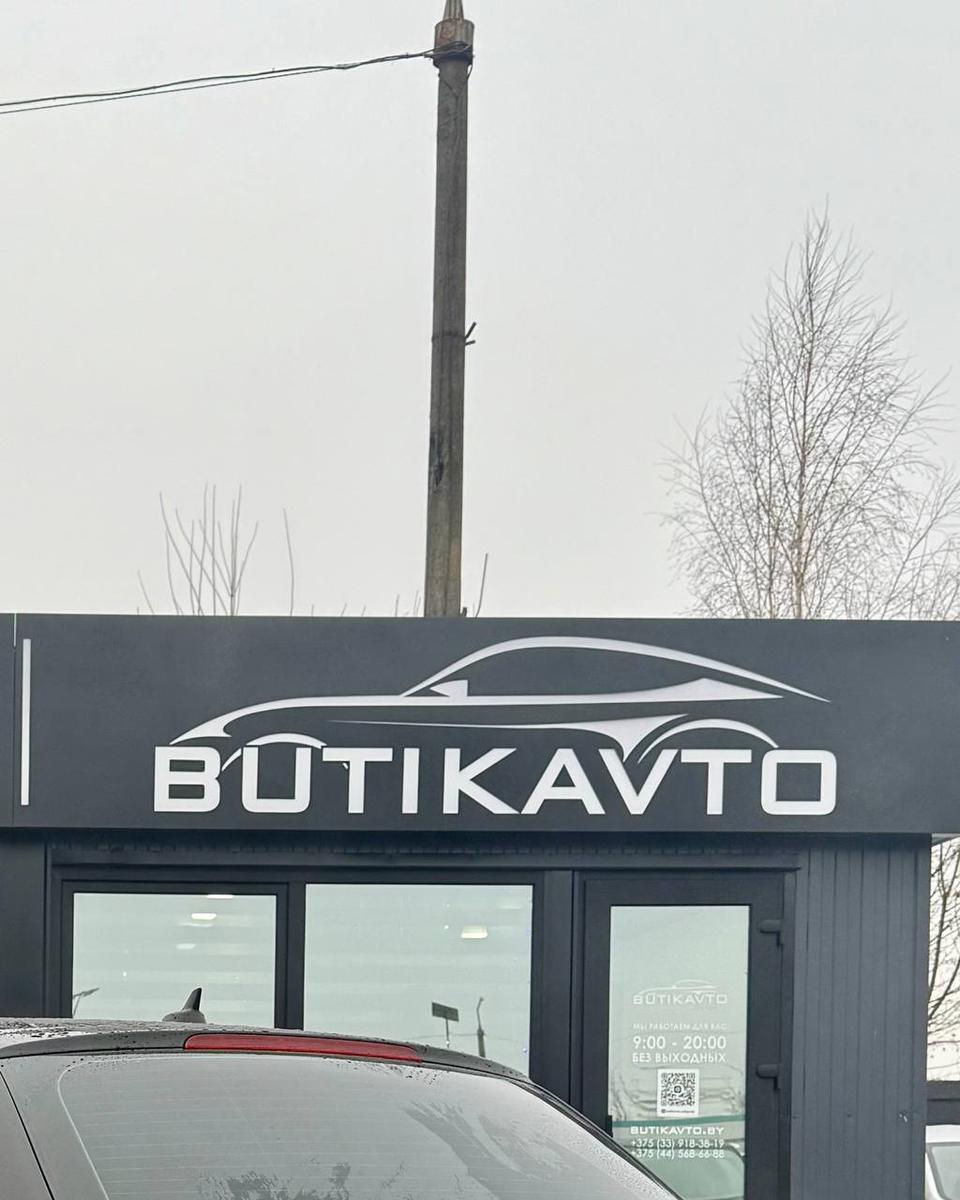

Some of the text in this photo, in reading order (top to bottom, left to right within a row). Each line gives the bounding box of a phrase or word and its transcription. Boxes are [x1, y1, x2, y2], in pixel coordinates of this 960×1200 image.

[153, 746, 838, 815] BUTIKAVTO
[632, 993, 728, 1005] BUTIKAVTO
[633, 1035, 666, 1049] 9:00
[683, 1035, 727, 1049] 20:00
[632, 1052, 727, 1064] БЕЗ ВЫХОДНЫХ
[630, 1126, 725, 1135] BUTIKAVTO.BY
[631, 1138, 725, 1149] +375 (33) 918-38-19
[631, 1149, 725, 1159] +375 (44) 568-66-88
